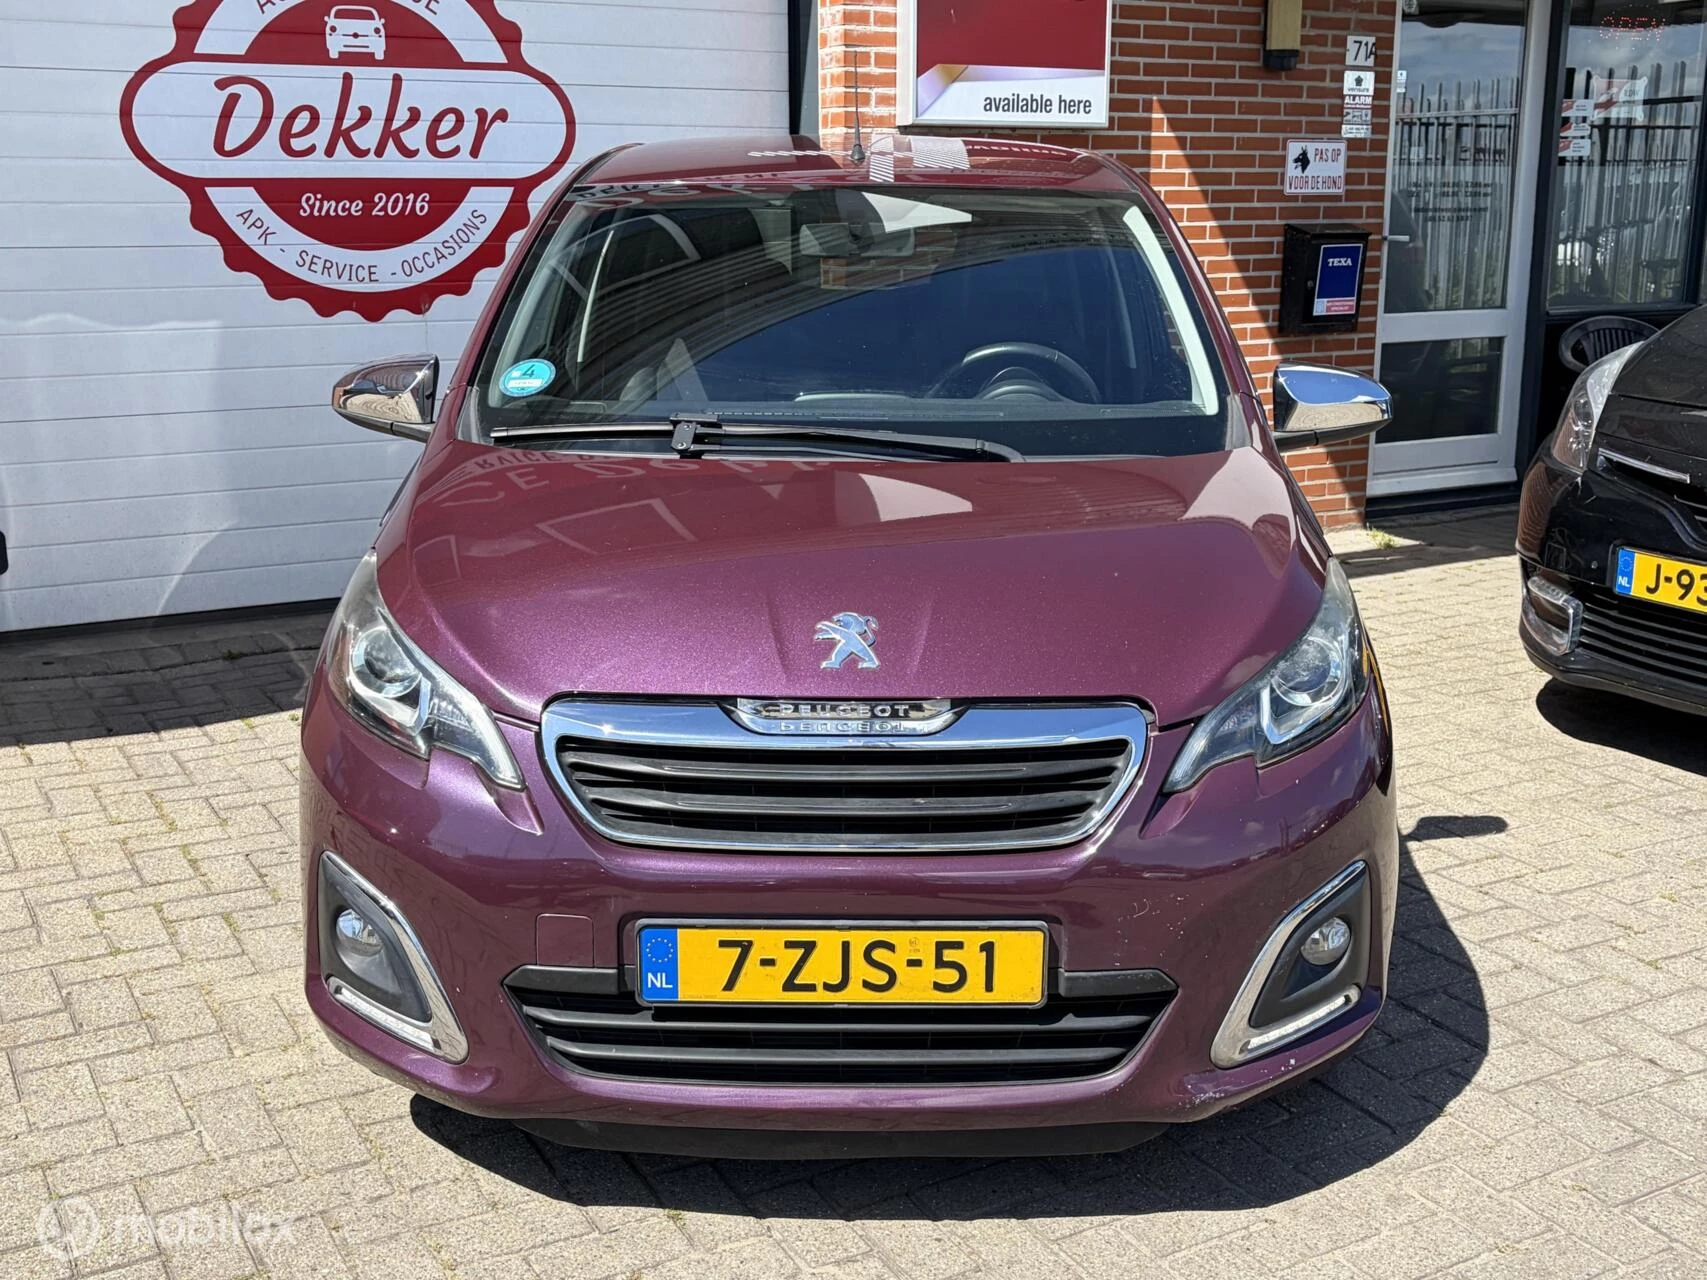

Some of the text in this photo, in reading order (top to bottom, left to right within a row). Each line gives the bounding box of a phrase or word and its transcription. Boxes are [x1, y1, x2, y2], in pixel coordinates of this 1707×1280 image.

[1353, 40, 1377, 62] 71A
[983, 92, 1092, 114] available here
[1344, 95, 1373, 104] ALARM
[212, 72, 509, 160] Dekker
[1313, 148, 1342, 162] PAS OP
[1288, 175, 1343, 191] VOOR DE HOND
[300, 192, 430, 217] Since 2016
[236, 208, 277, 246] APK
[295, 249, 378, 282] SERVICE
[1327, 257, 1352, 267] TEXA
[522, 364, 535, 377] 4
[1617, 575, 1631, 587] NL
[780, 703, 910, 719] PEUGEOT
[718, 939, 995, 993] 7-ZJS-51
[647, 972, 673, 988] NL
